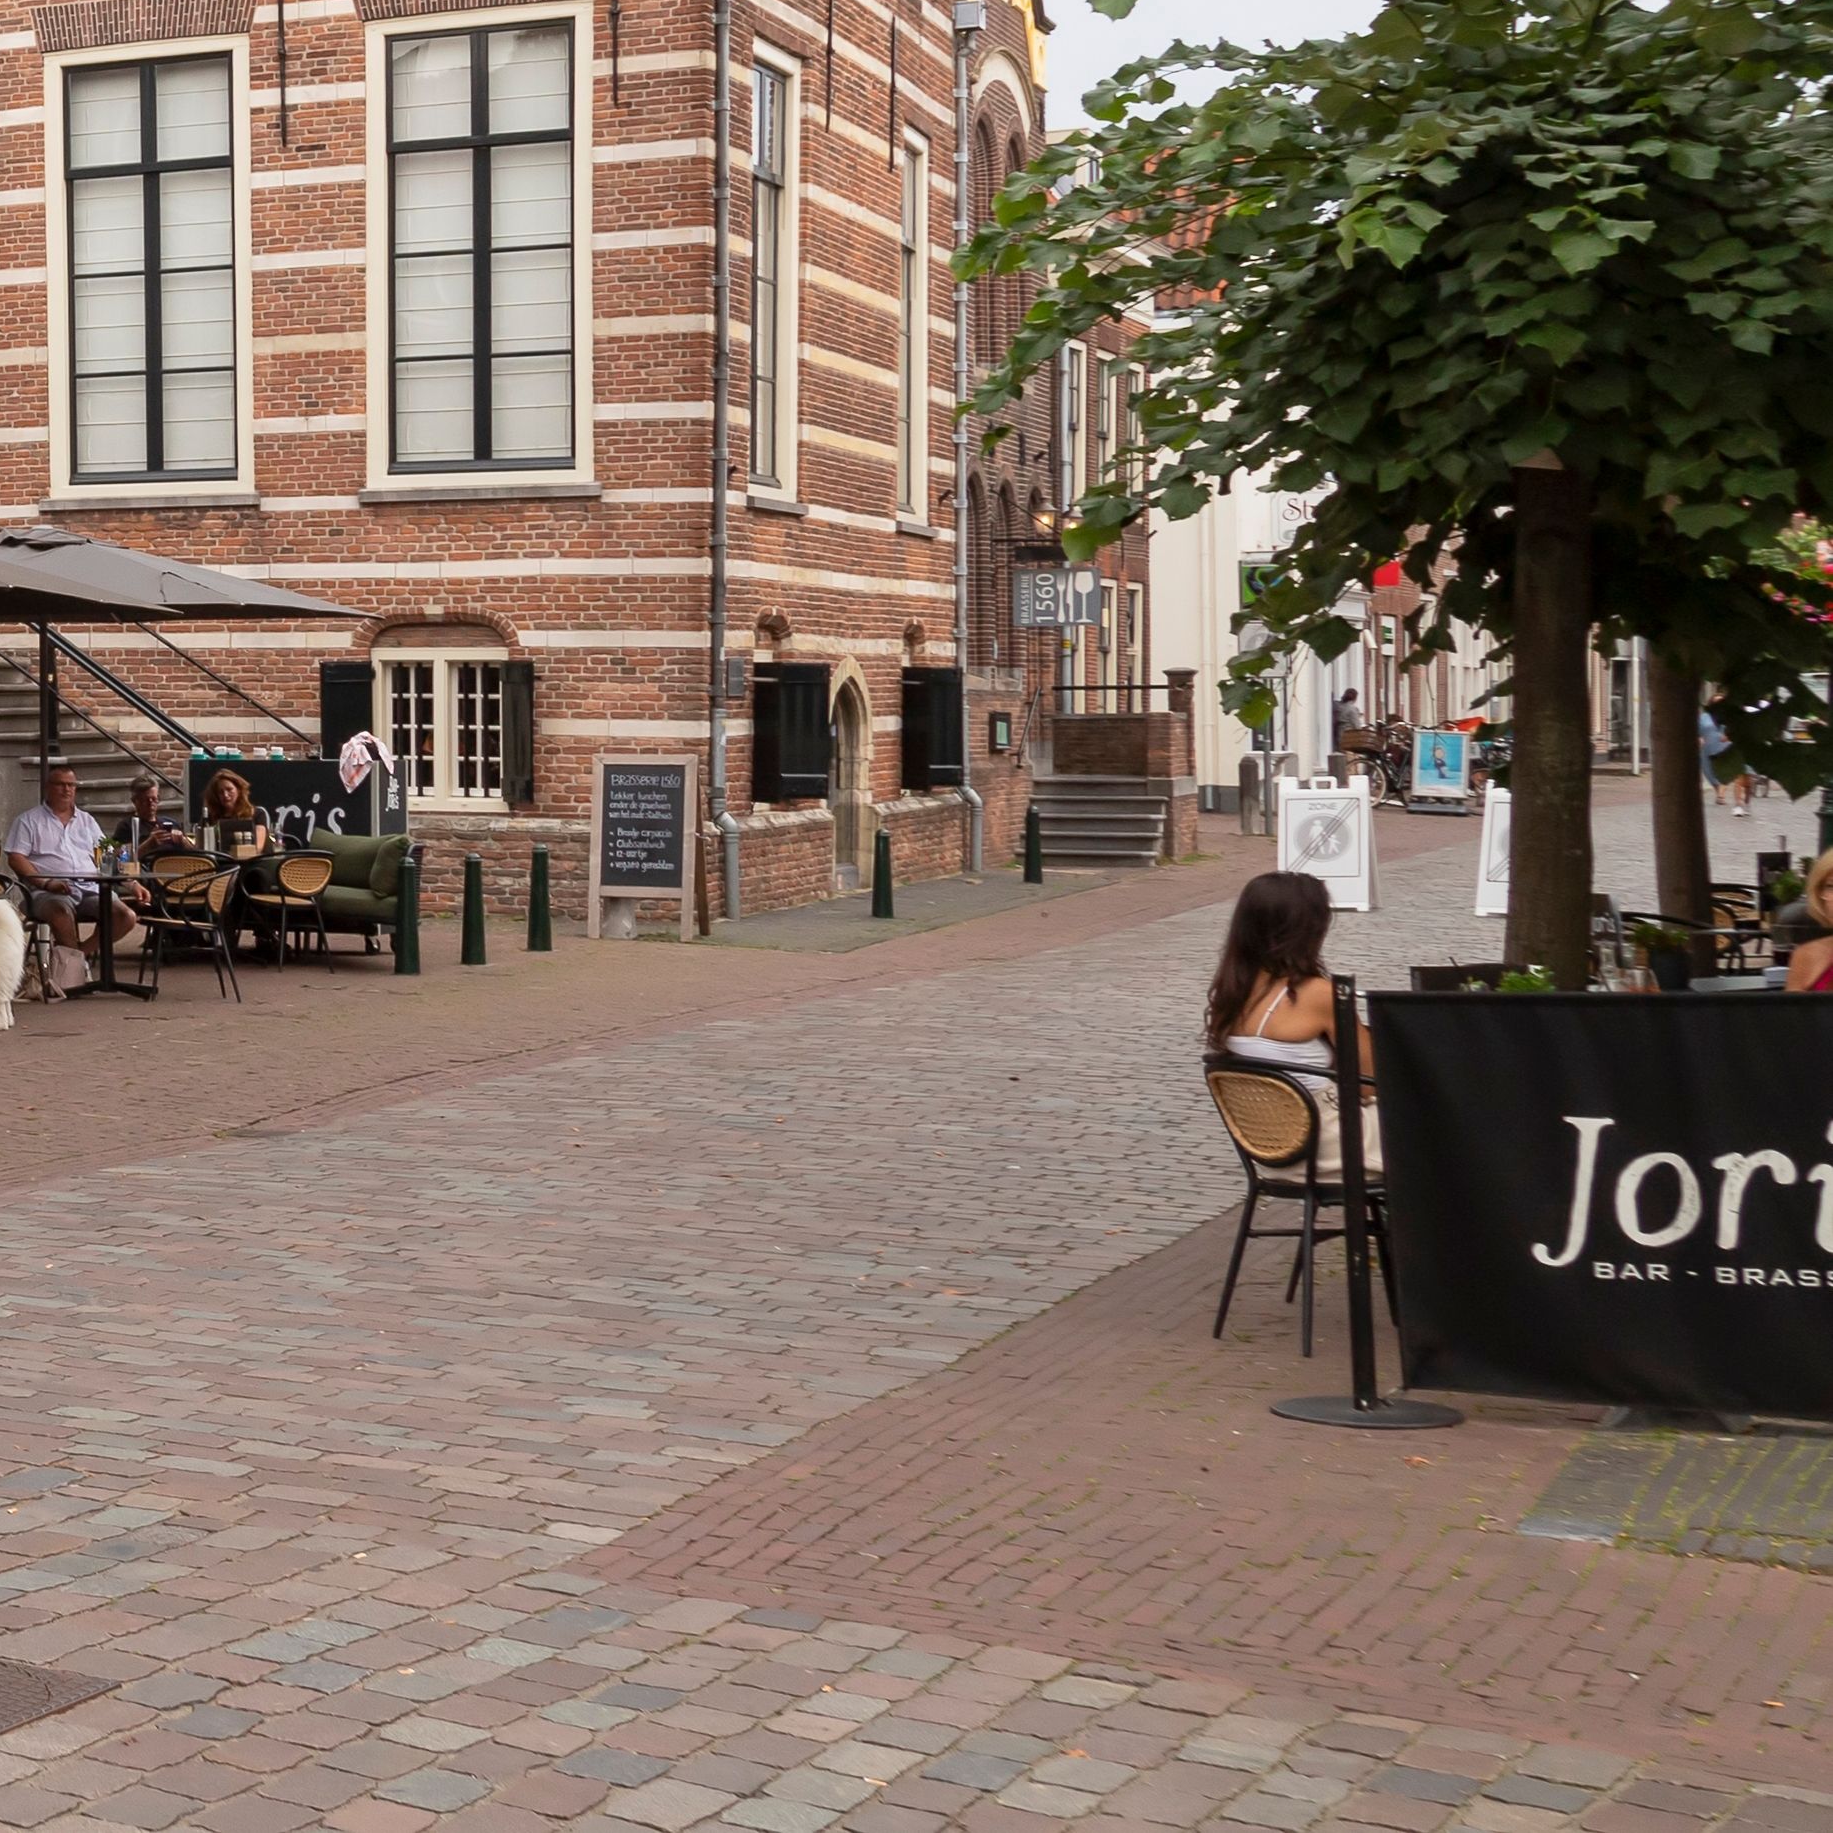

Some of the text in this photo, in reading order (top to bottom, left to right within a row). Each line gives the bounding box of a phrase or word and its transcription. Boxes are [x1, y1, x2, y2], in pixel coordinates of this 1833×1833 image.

[1020, 574, 1030, 624] BRASSERIE
[1035, 573, 1055, 624] 1560
[1309, 803, 1337, 811] ZONE
[1592, 1261, 1671, 1282] BAR
